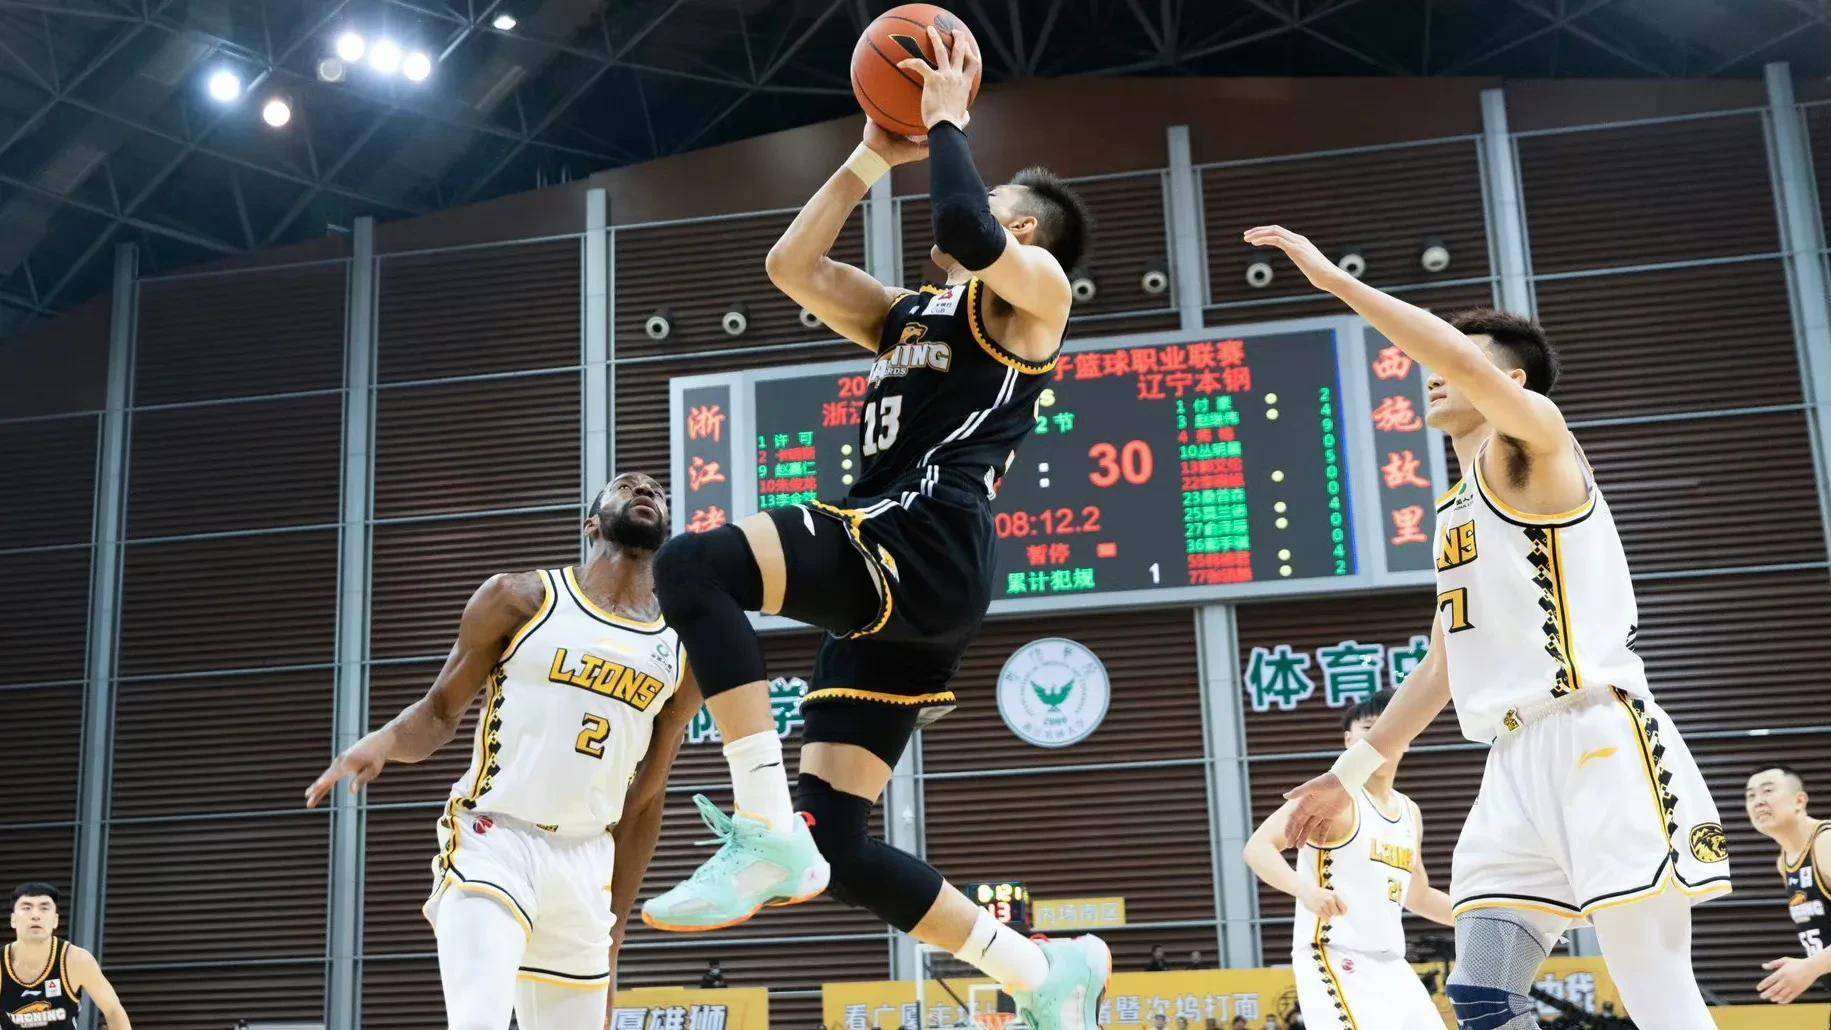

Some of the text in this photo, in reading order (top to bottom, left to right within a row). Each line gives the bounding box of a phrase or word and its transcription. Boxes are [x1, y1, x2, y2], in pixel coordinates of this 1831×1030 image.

[1137, 367, 1251, 399] 辽宁本钢
[1319, 387, 1330, 402] 2
[863, 395, 902, 457] 13
[758, 435, 767, 448] 1
[1371, 346, 1432, 545] 西施故里
[758, 450, 767, 463] 2
[1088, 439, 1153, 488] 30
[758, 464, 767, 478] 9
[994, 506, 1101, 538] 08:12.2
[1026, 542, 1071, 566] 暂停
[1334, 559, 1347, 575] 2
[1007, 568, 1095, 594] 累计犯规
[1149, 562, 1161, 584] 1
[549, 648, 664, 712] LIONS
[575, 713, 610, 759] 2
